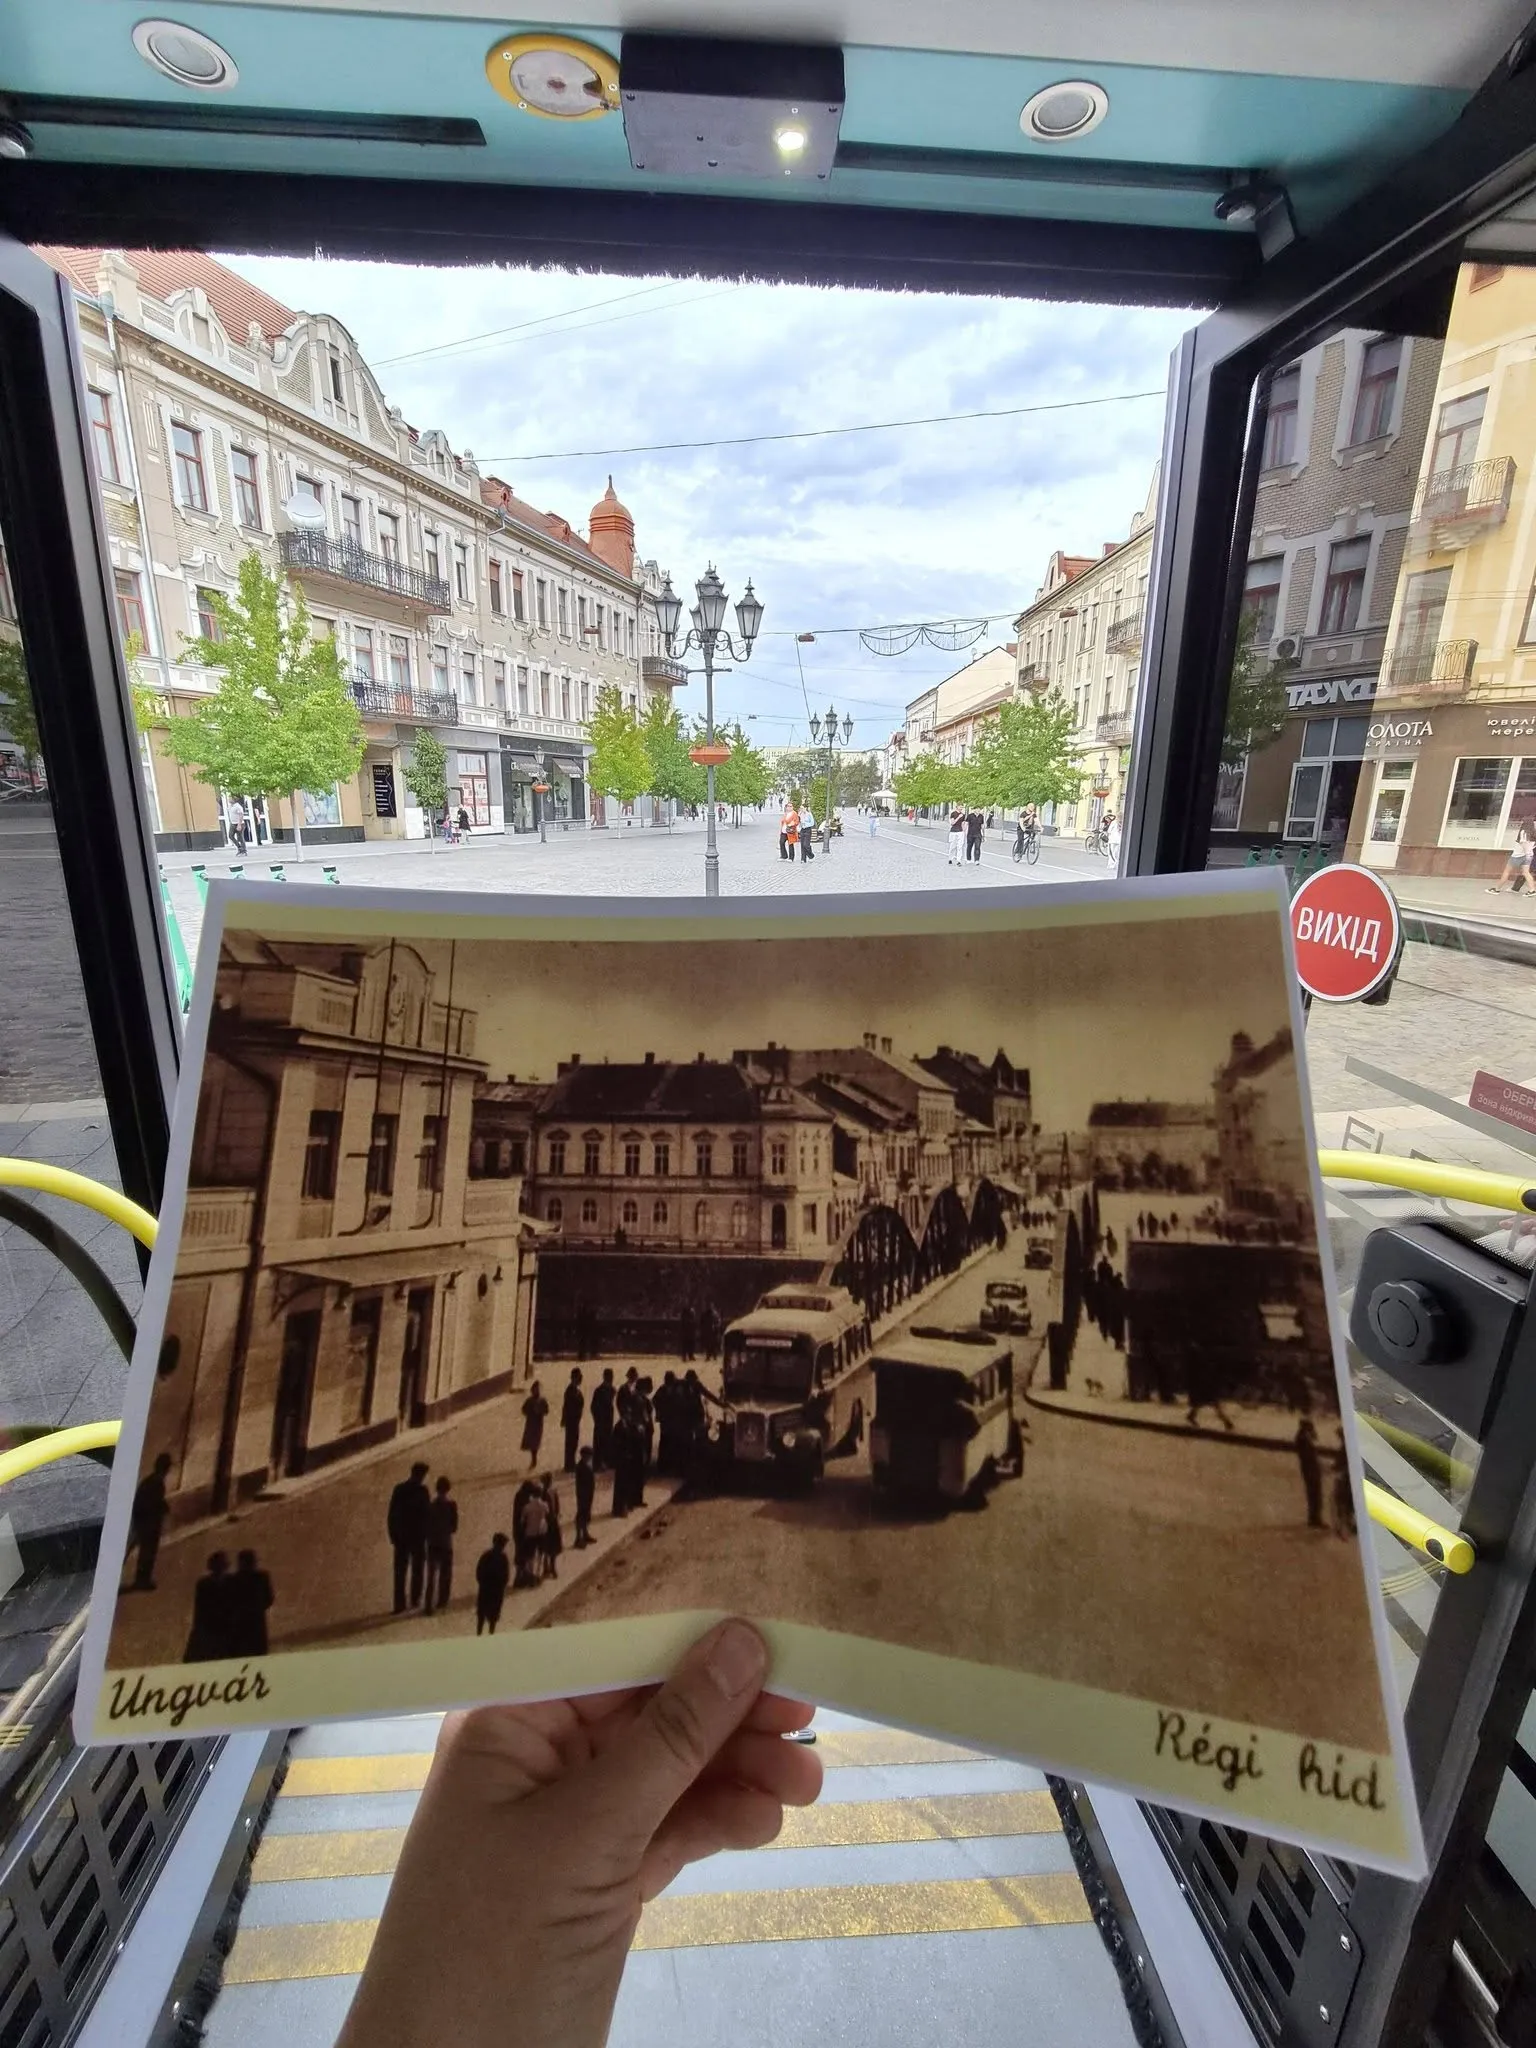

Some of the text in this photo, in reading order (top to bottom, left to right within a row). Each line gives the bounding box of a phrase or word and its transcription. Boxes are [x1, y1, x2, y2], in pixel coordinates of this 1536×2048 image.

[1367, 720, 1433, 739] ОЛОТА
[1296, 906, 1382, 963] ВИХІД
[1477, 1093, 1499, 1109] Зона
[109, 1664, 270, 1727] Ungvár
[1155, 1710, 1386, 1810] Régi hid
